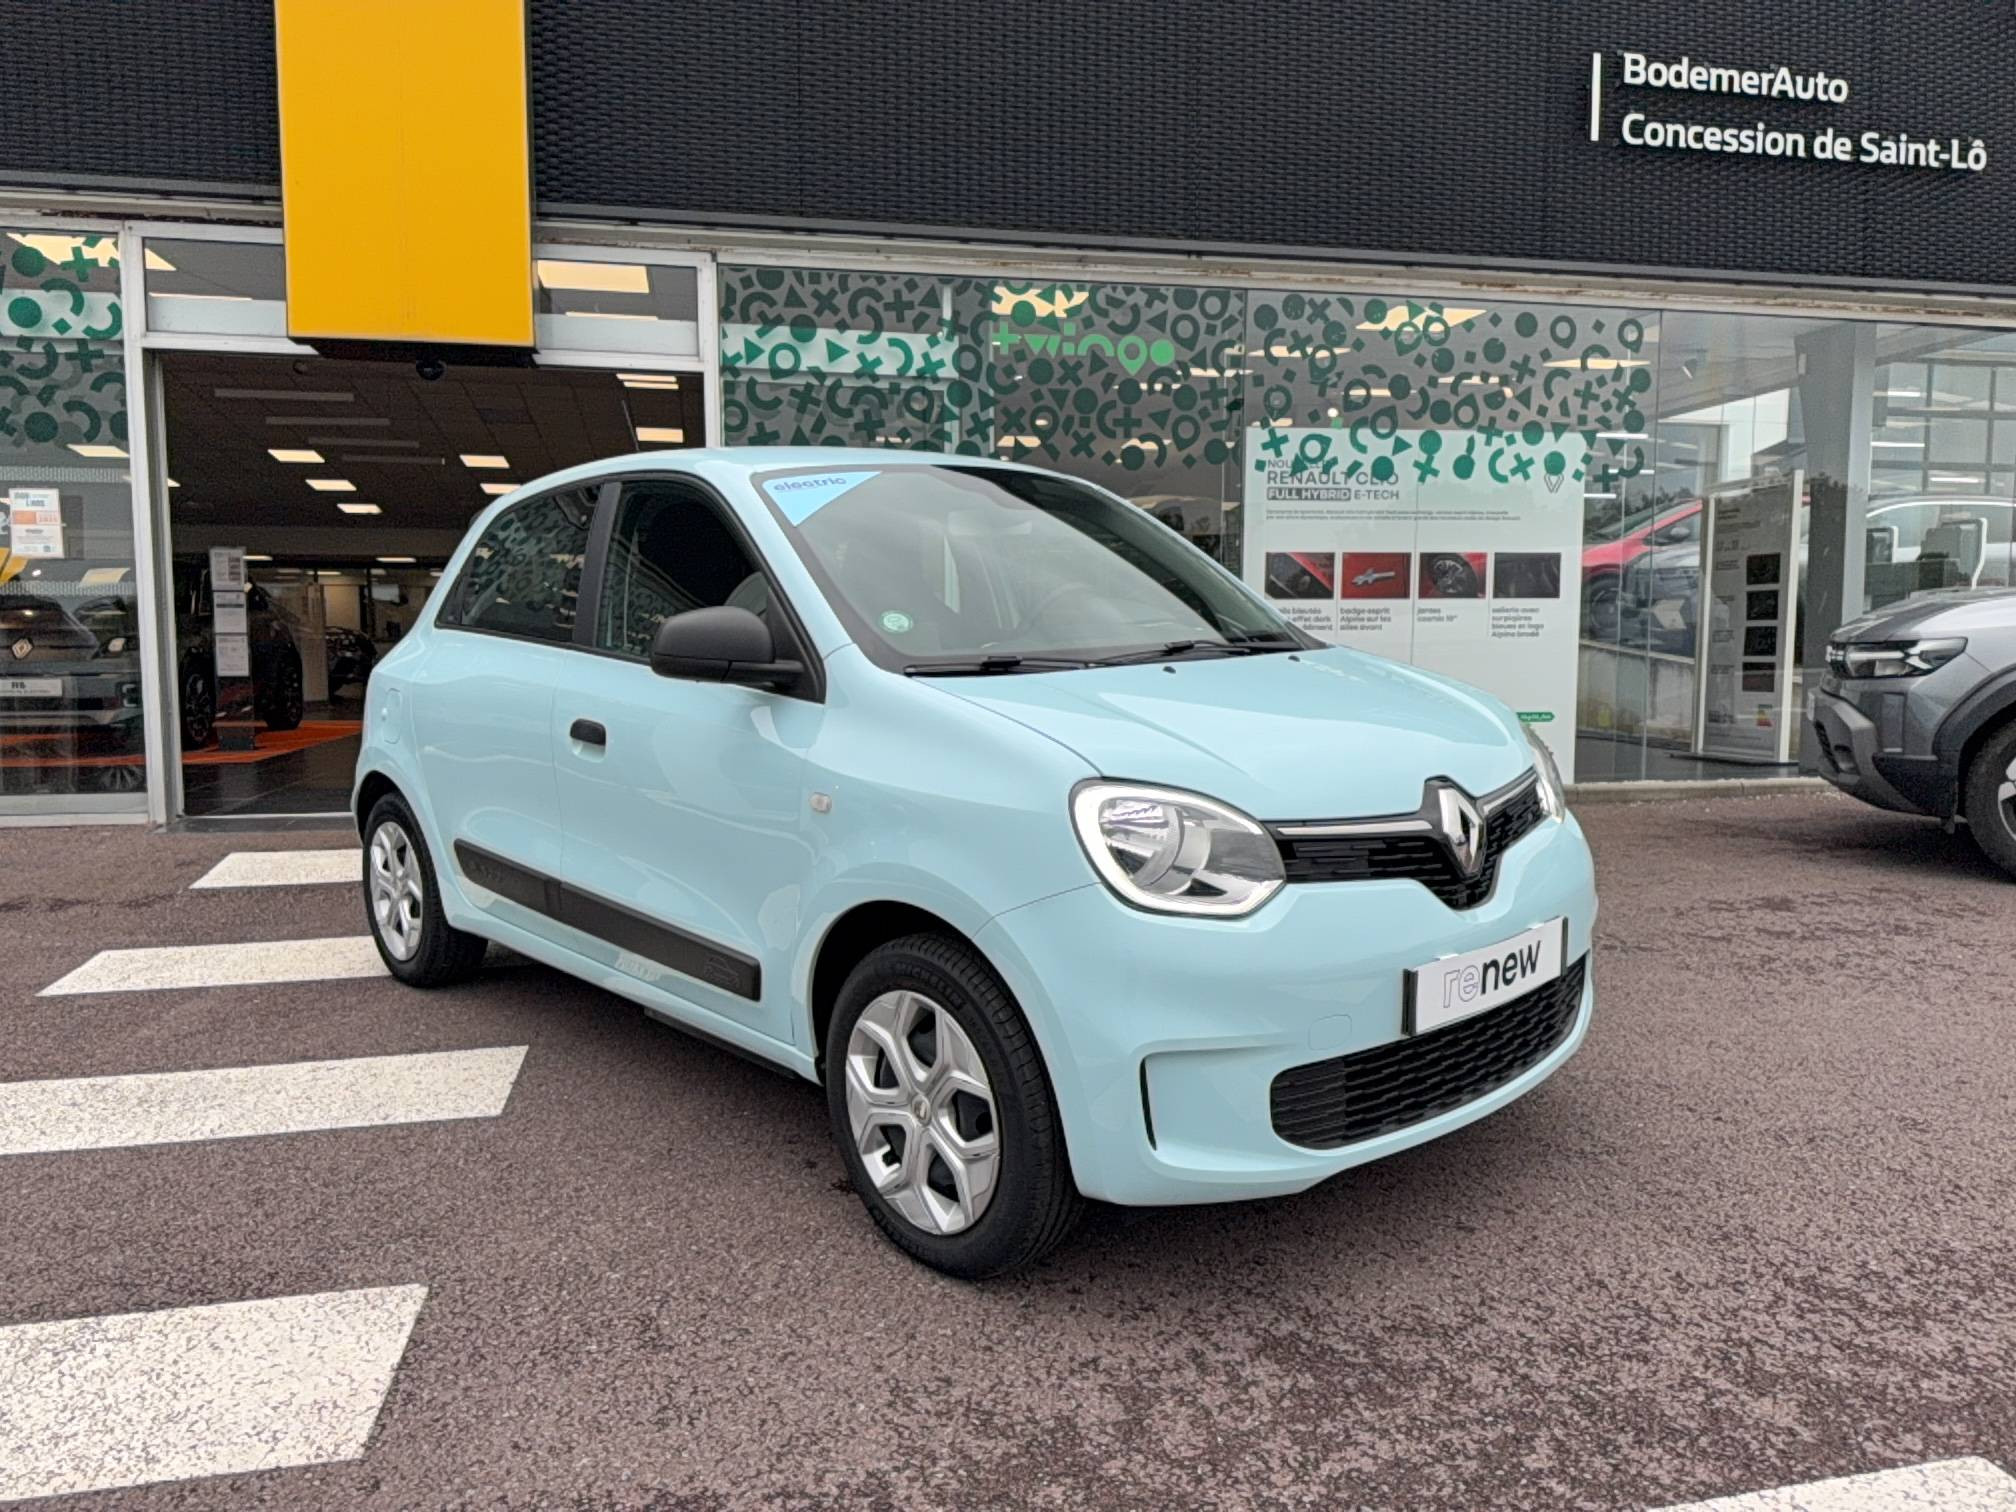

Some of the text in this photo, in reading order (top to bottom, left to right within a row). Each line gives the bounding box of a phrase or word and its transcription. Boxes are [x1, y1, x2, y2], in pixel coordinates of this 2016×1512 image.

[1623, 52, 1848, 103] BodemerAuto
[1621, 113, 1987, 171] Concession de Saint-Lô
[774, 477, 847, 491] electric
[1268, 488, 1400, 500] FULL HYBRID E-TECH
[1443, 939, 1542, 1009] renew
